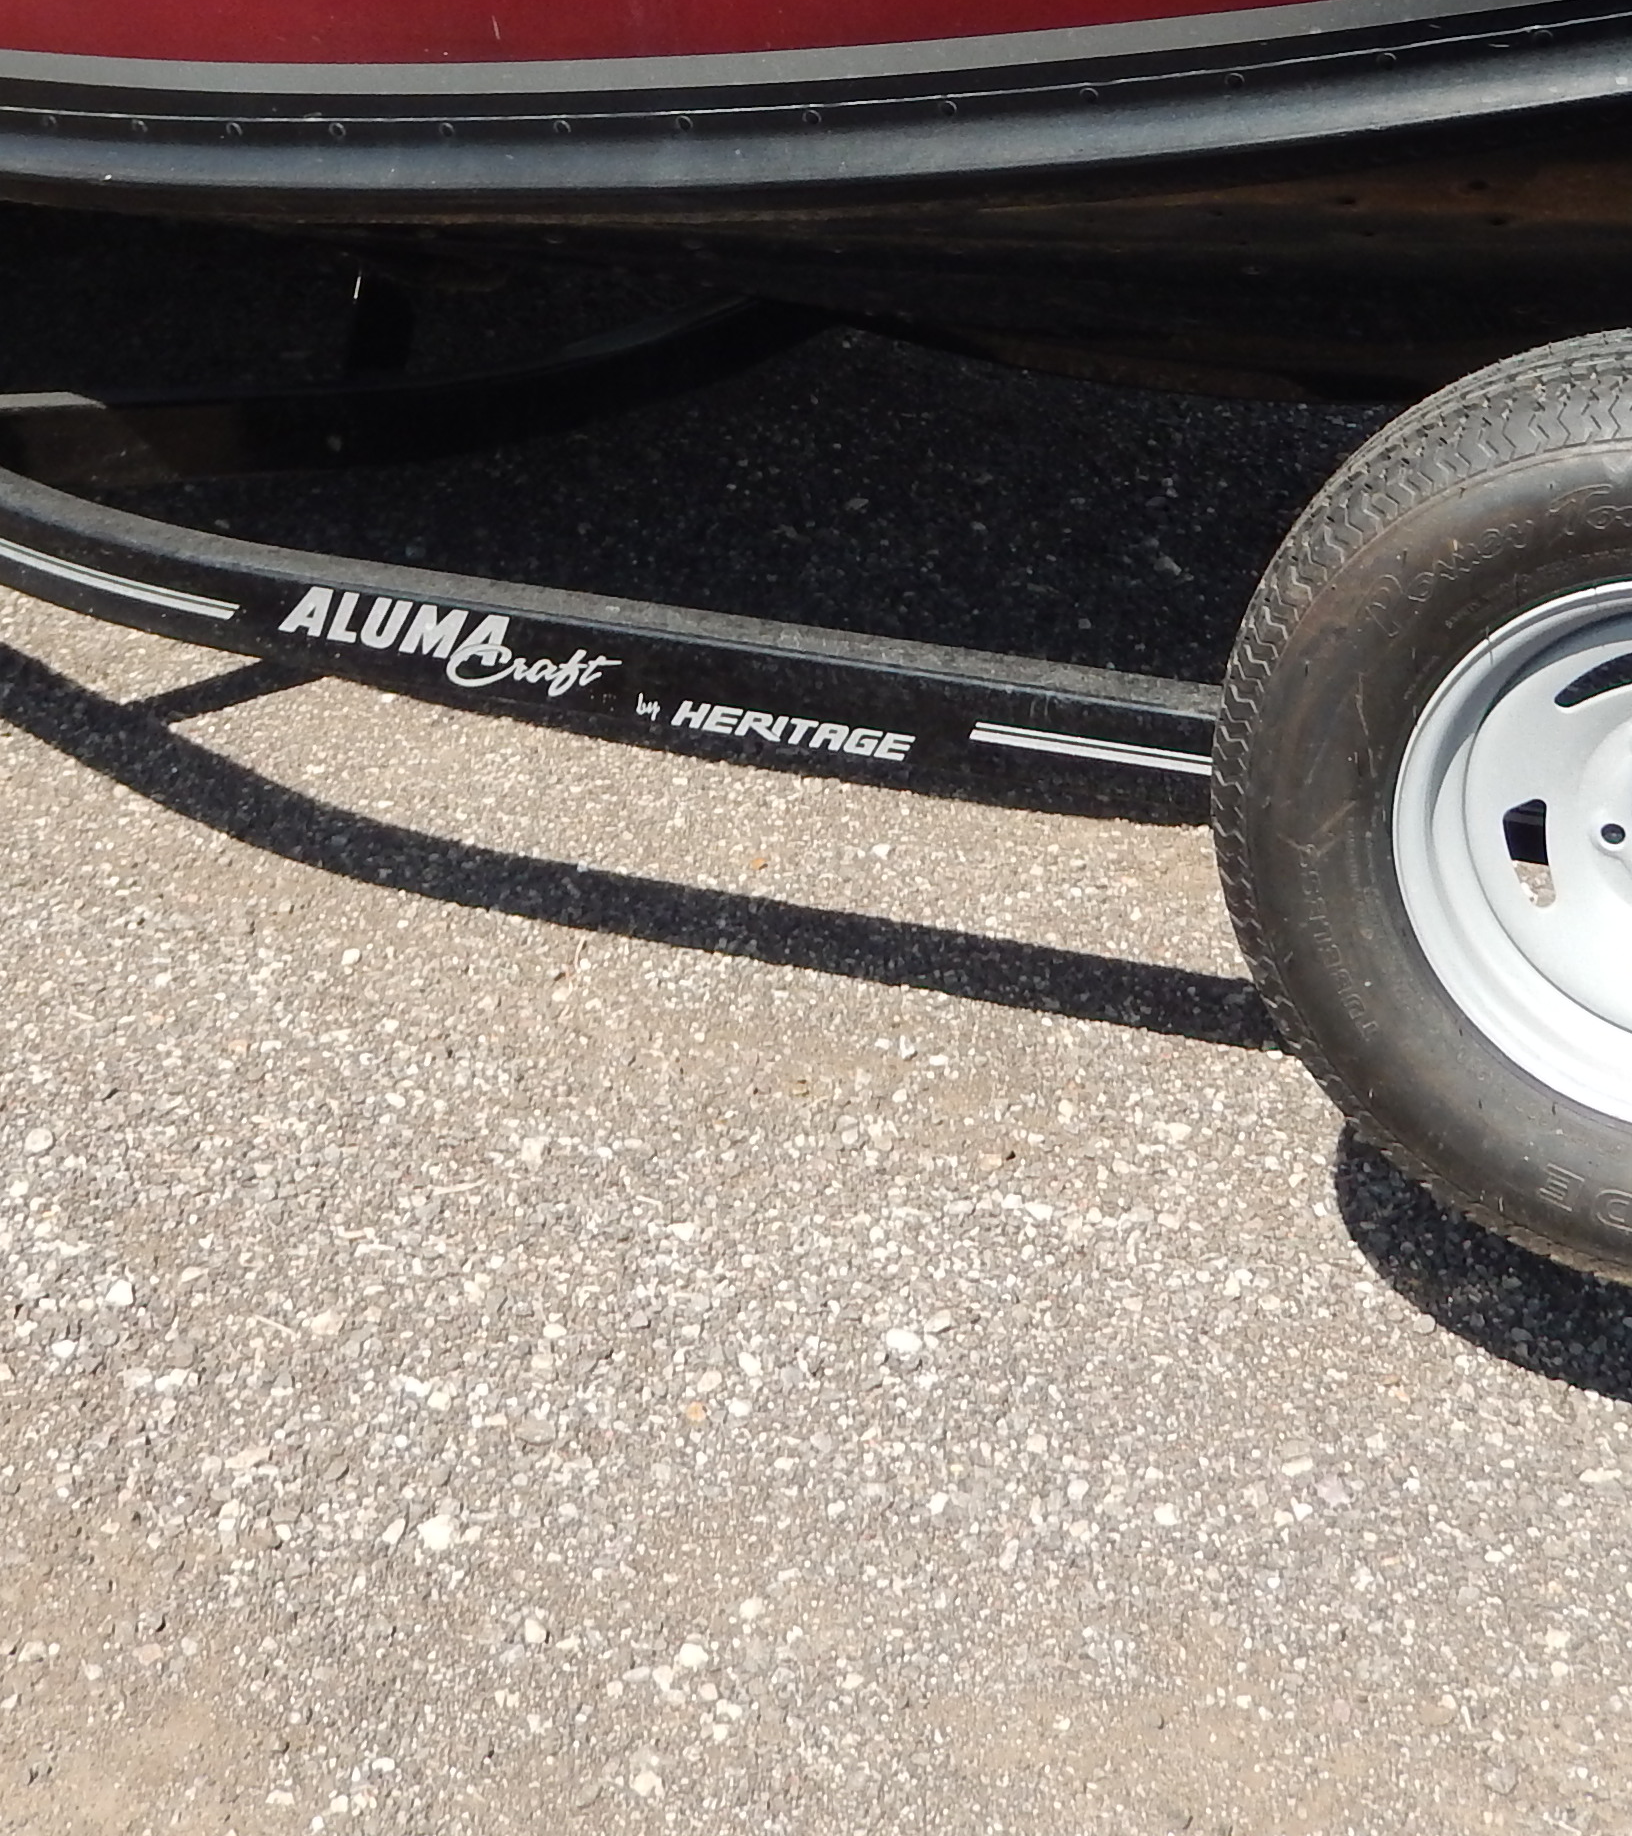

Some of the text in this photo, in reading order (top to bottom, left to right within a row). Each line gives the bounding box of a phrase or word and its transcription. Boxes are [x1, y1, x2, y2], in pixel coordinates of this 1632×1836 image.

[278, 586, 622, 697] ALUMA Craft
[636, 693, 916, 761] by HERITAGE
